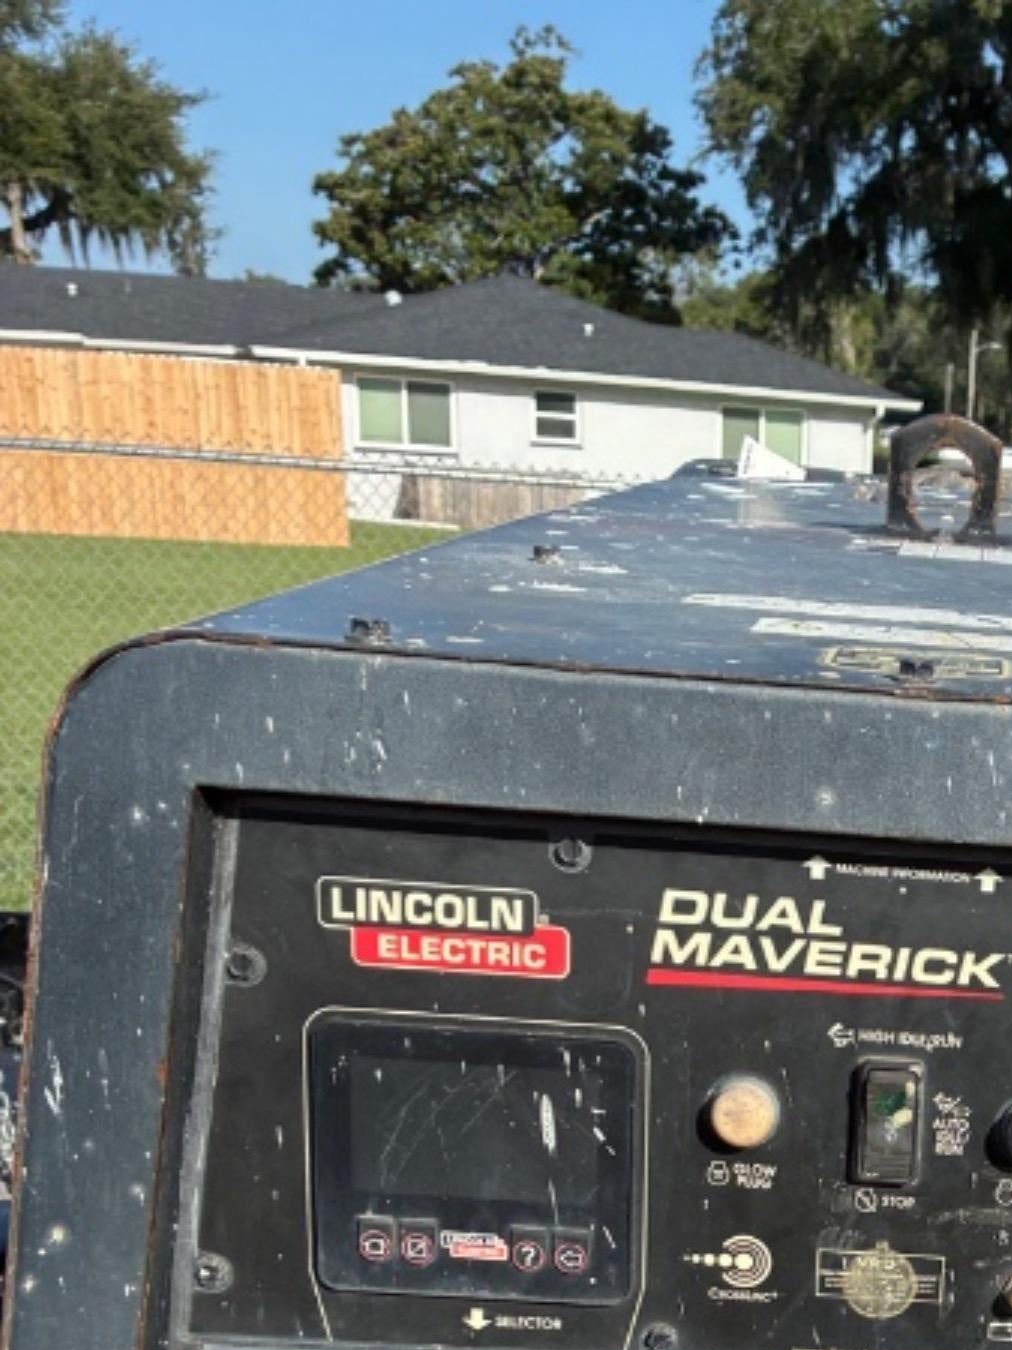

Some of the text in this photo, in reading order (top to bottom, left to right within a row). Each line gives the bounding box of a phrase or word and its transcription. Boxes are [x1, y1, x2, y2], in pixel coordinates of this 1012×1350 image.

[331, 887, 524, 931] LINCOLN
[659, 888, 844, 936] DUAL
[377, 934, 548, 968] ELECTRIC
